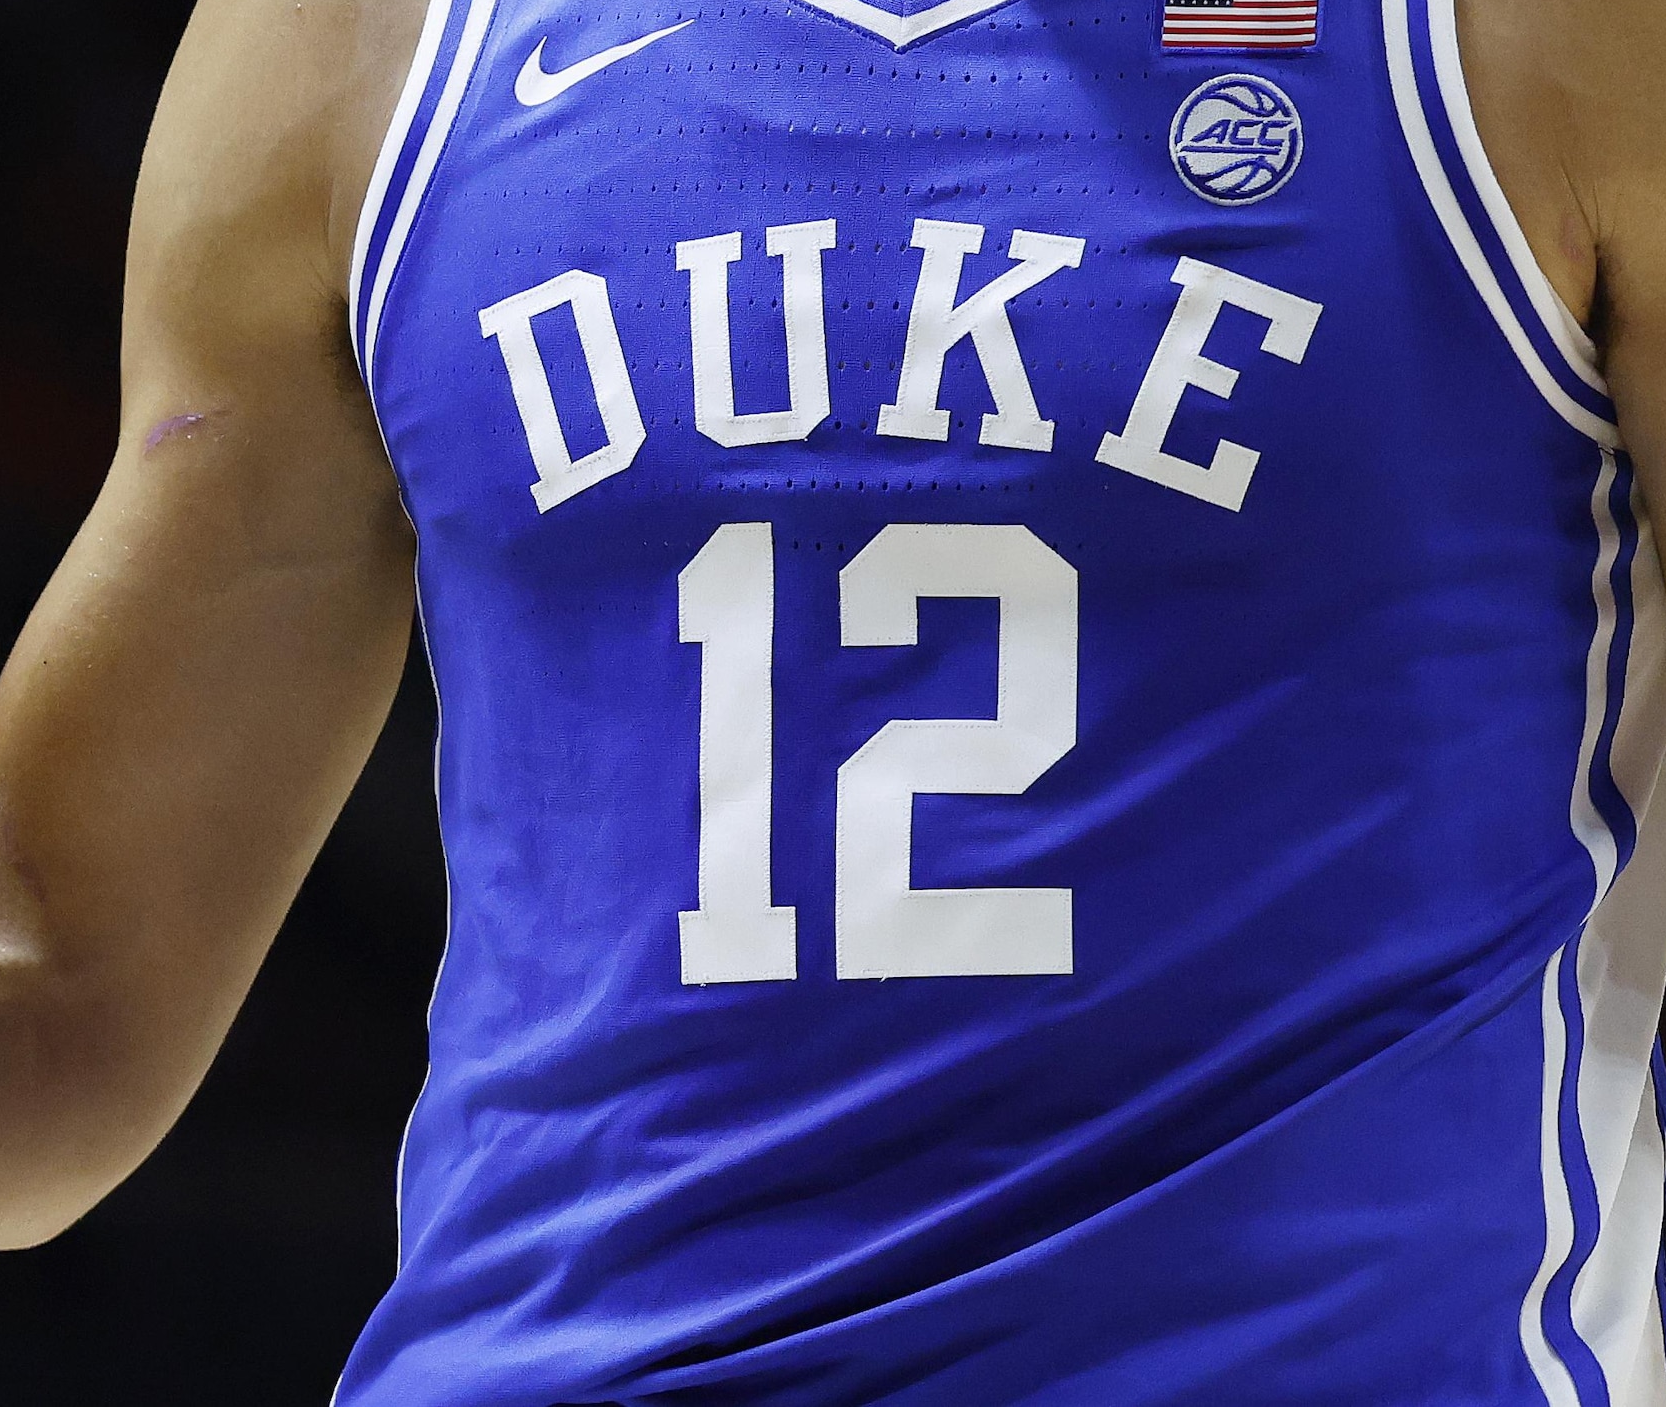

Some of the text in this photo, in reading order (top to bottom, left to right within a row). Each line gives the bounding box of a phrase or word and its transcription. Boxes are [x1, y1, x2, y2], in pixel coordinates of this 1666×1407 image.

[1190, 118, 1294, 147] ACC
[477, 217, 1324, 514] DUKE
[677, 521, 1080, 987] 12
